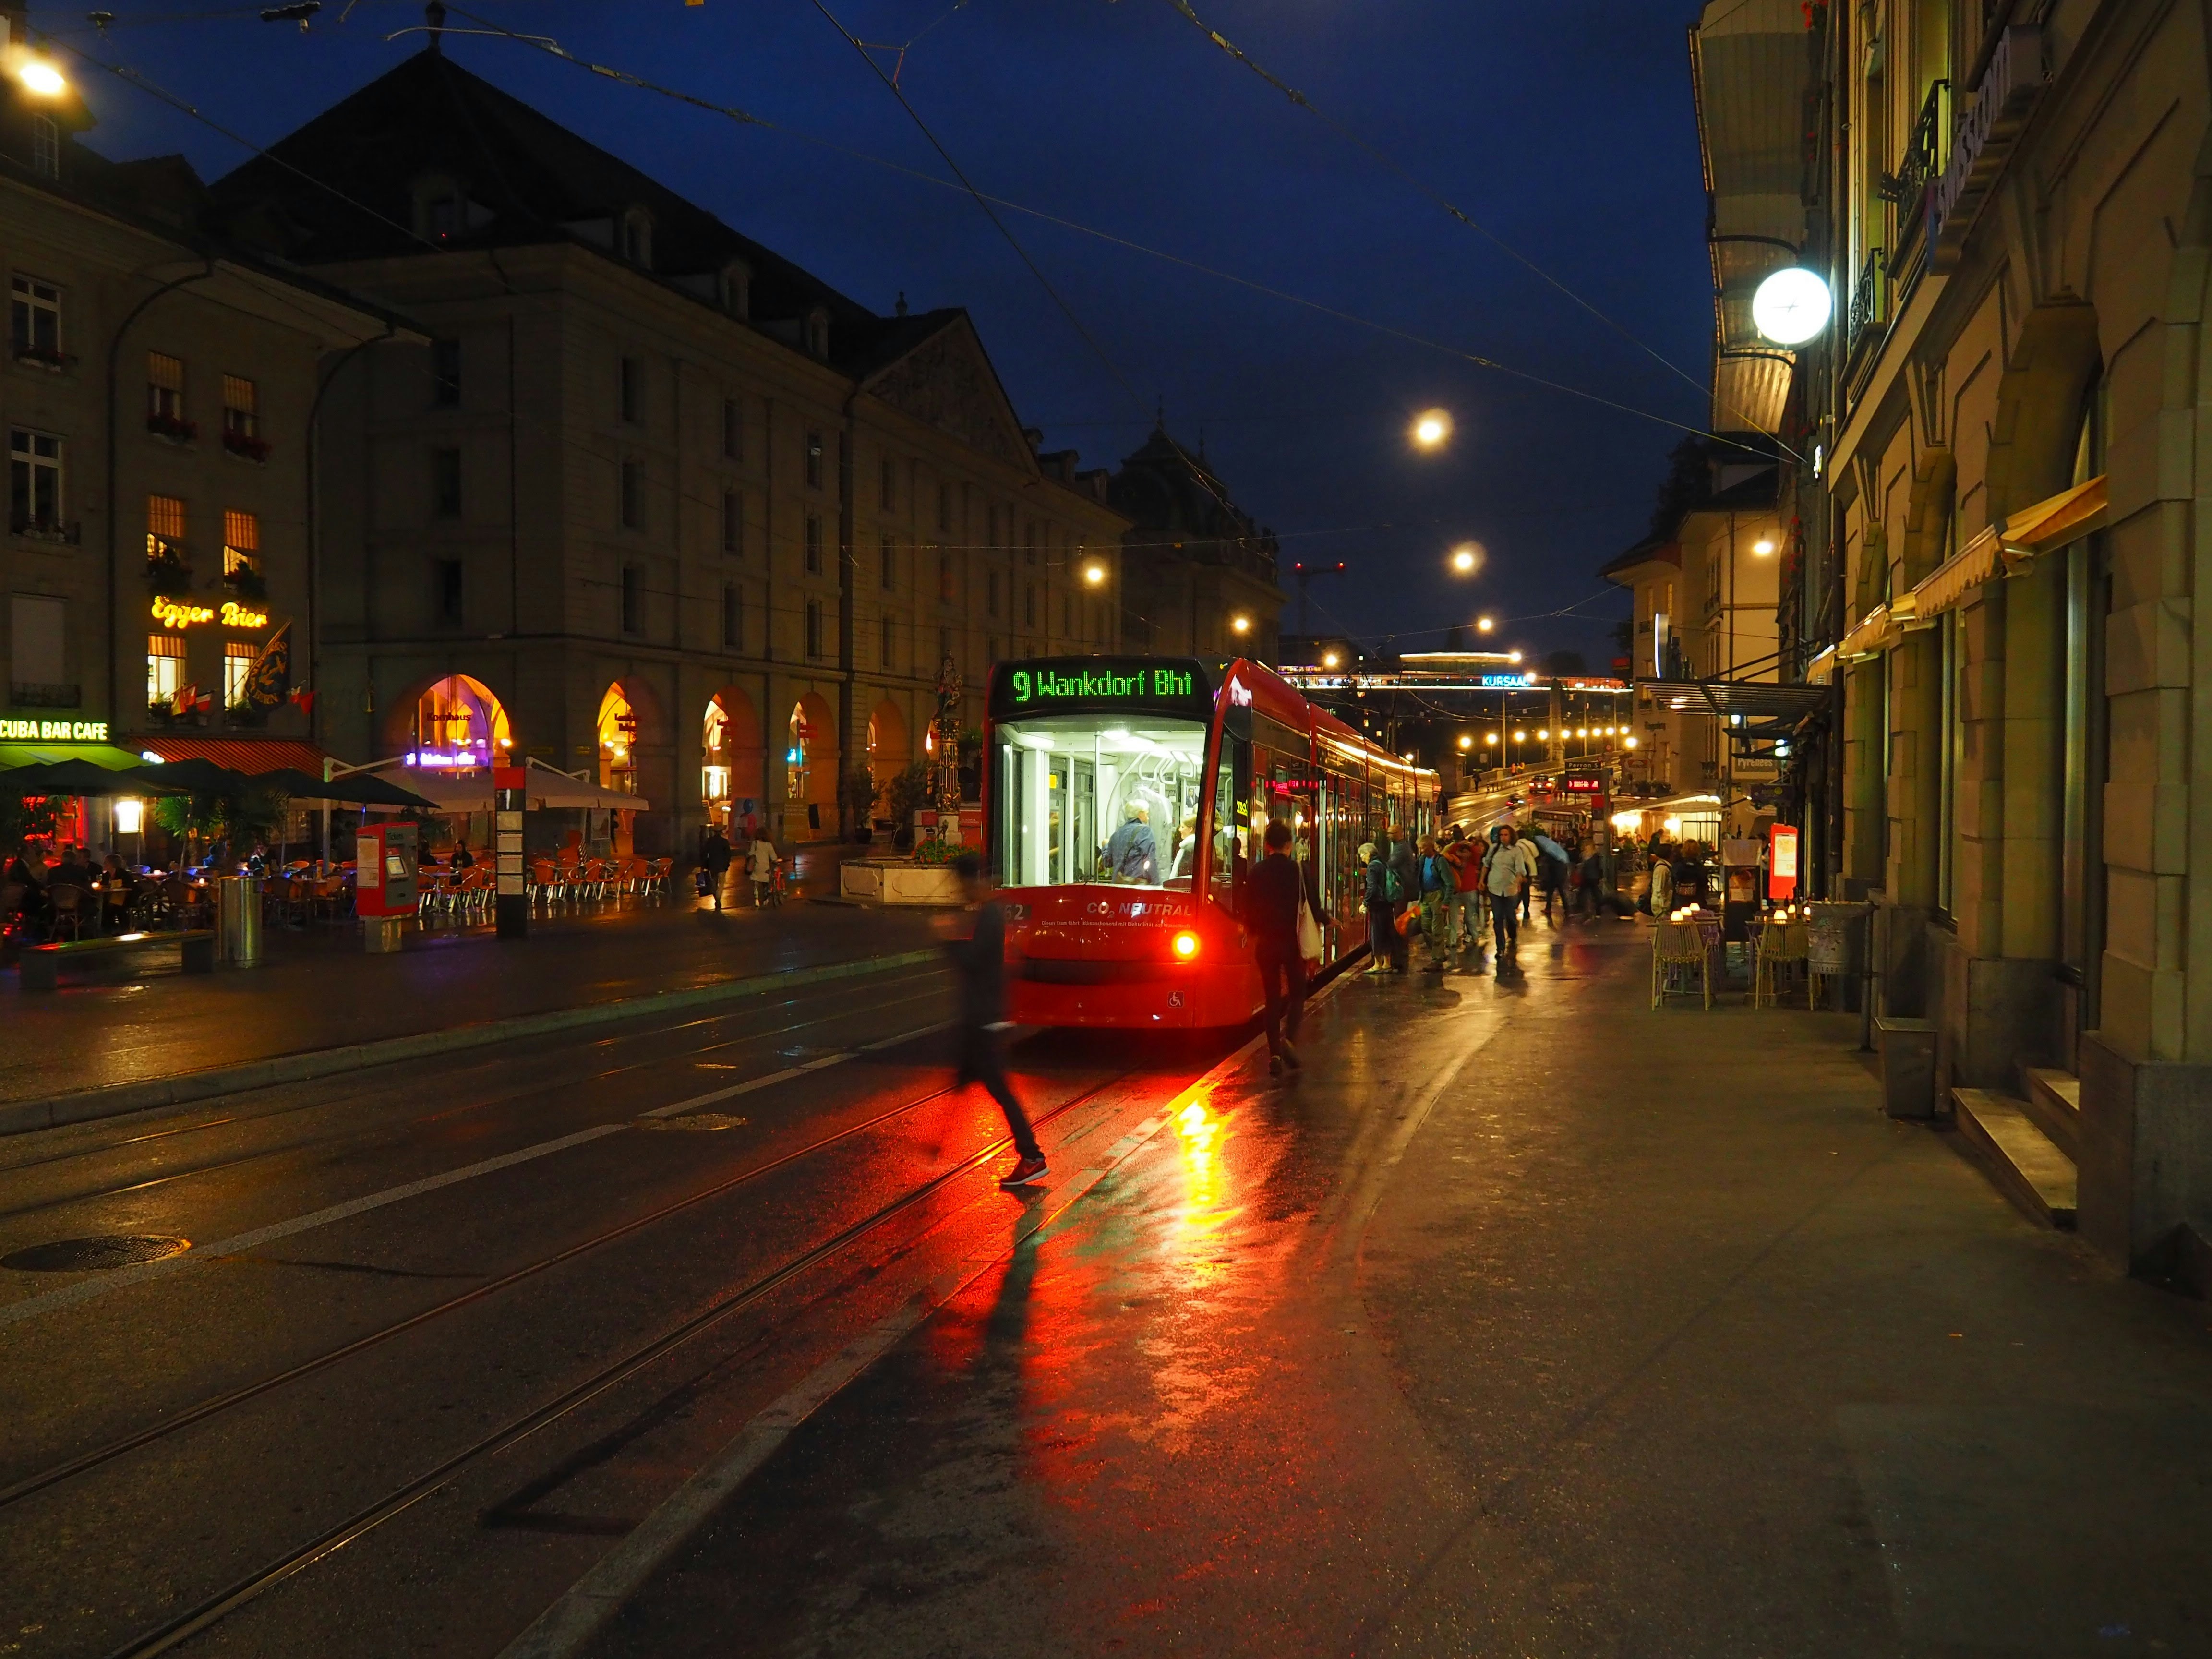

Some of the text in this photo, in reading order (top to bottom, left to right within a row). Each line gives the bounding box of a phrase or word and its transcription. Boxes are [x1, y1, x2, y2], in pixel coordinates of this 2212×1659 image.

[220, 602, 268, 628] Bier
[1013, 671, 1031, 702] 9
[1037, 670, 1145, 696] Wankdorf
[426, 711, 471, 721] Kornhaus
[0, 719, 108, 740] CUBA BAR CAFE
[1118, 902, 1191, 916] NEUTRAL
